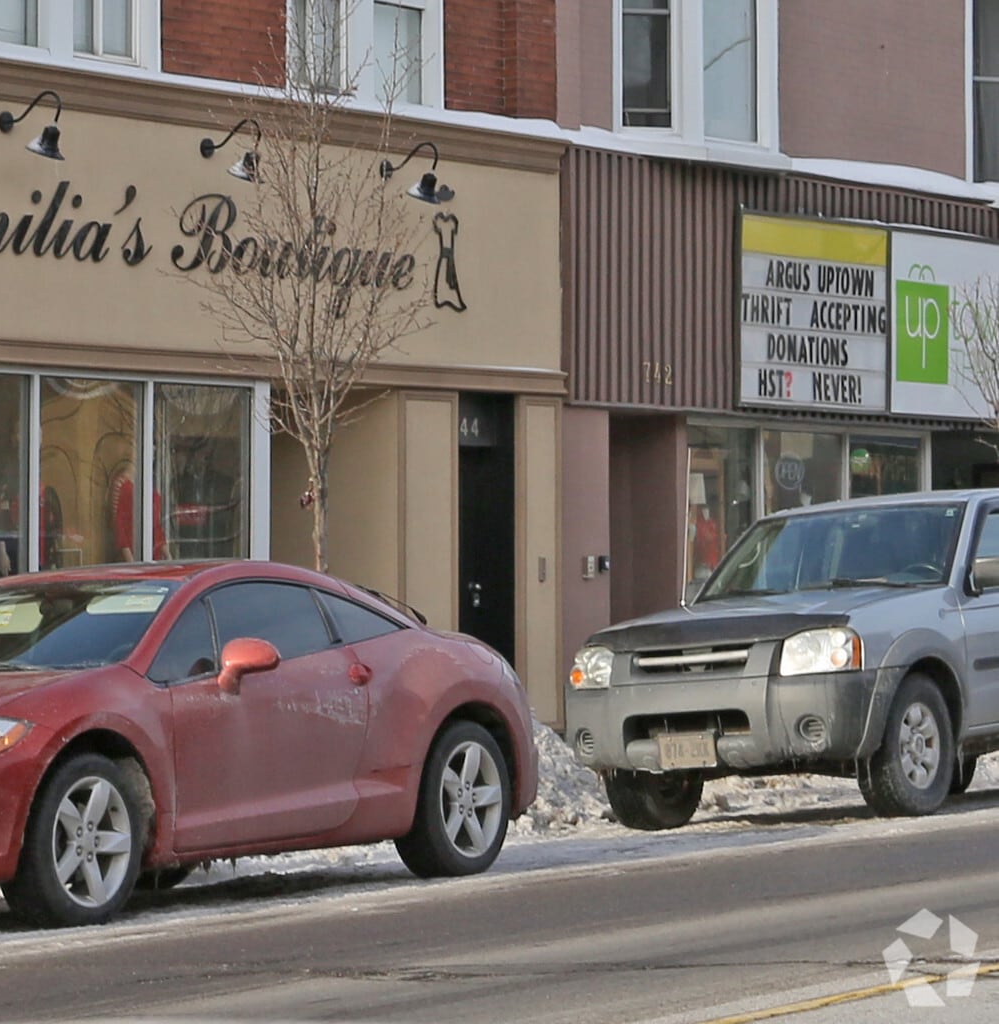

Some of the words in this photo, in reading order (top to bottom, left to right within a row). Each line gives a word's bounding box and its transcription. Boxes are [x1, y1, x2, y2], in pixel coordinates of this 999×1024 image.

[765, 259, 811, 291] ARGUS
[817, 264, 874, 297] UPTOWN
[742, 293, 792, 326] THRIFT
[810, 300, 887, 334] ACCEPTING
[767, 333, 848, 366] DONATIONS
[642, 361, 672, 385] 742
[758, 368, 793, 398] HST?
[812, 371, 862, 404] NEVER!
